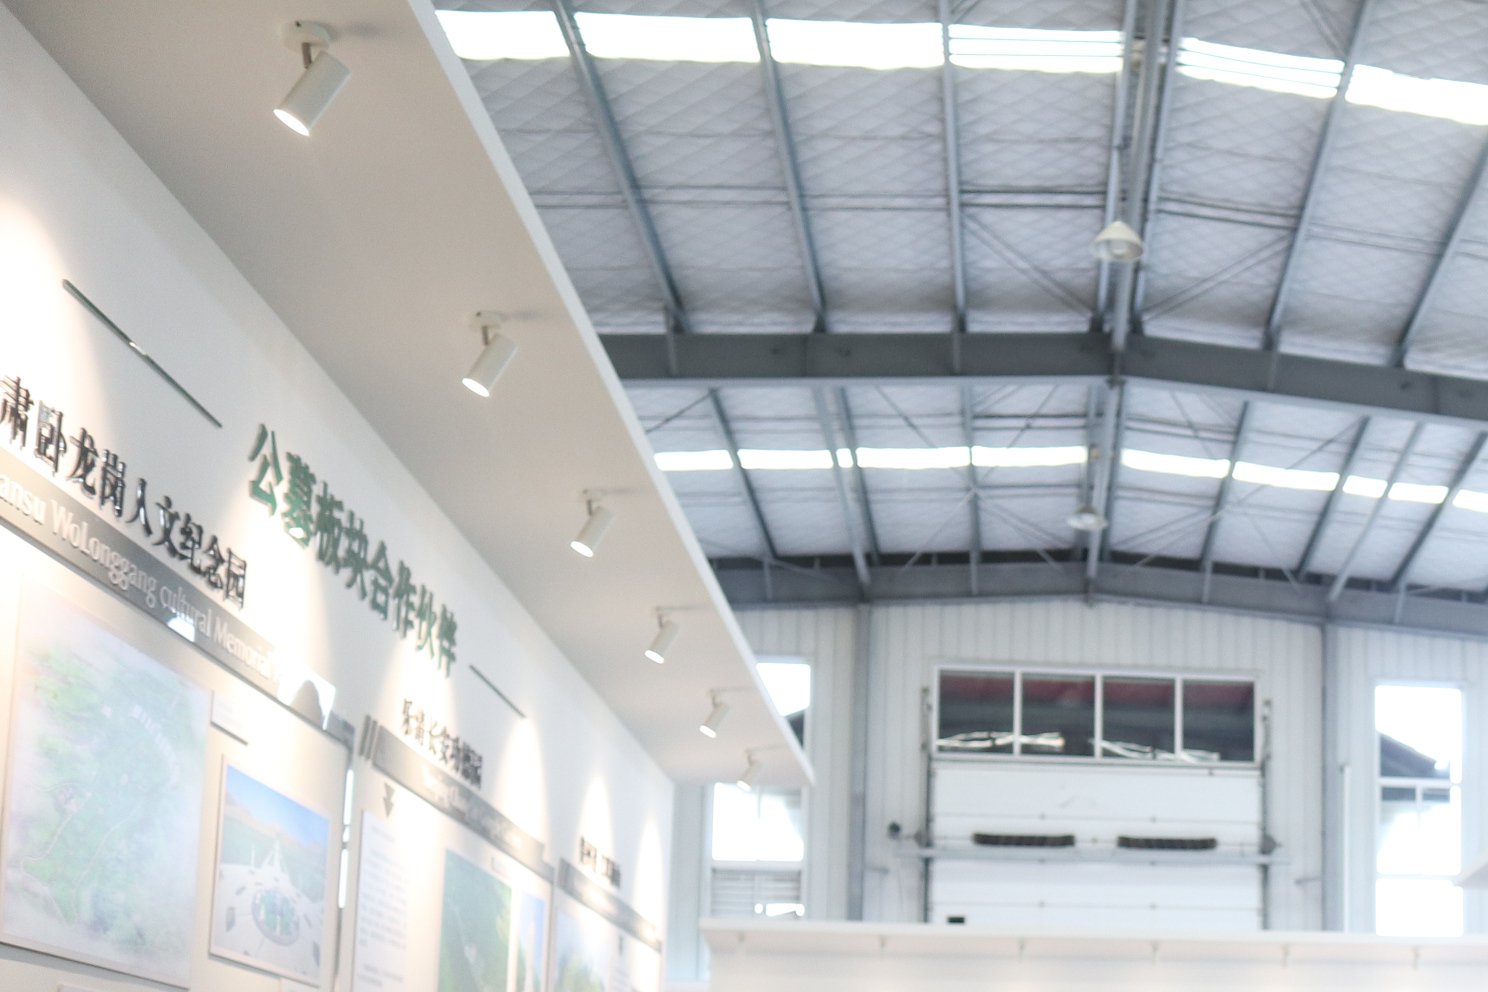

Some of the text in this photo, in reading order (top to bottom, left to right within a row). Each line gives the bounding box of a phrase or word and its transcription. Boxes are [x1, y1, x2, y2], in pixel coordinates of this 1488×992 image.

[248, 423, 457, 678] 公墓板块合作伙伴
